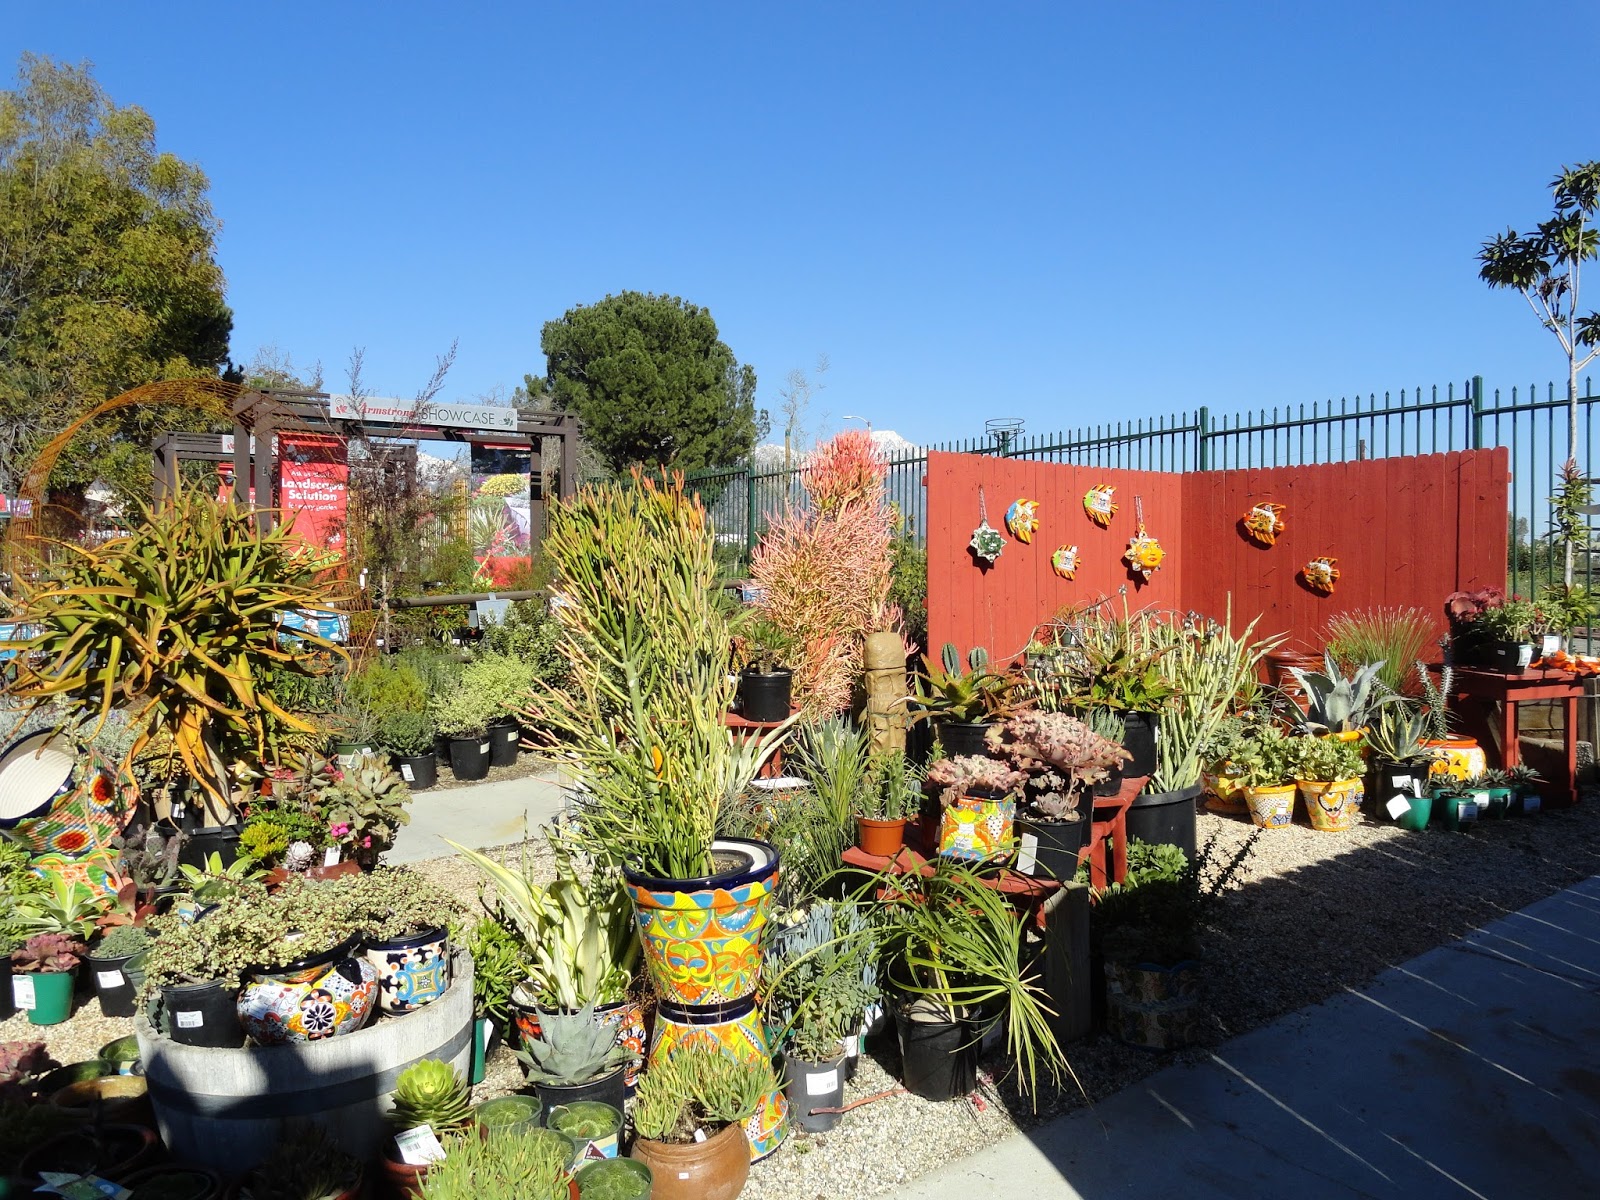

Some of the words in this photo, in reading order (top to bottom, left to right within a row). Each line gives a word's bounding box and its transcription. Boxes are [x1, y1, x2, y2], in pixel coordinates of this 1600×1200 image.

[358, 402, 417, 419] Armstrong
[421, 407, 495, 425] SHOWCASE
[281, 477, 345, 492] Landscape
[288, 489, 337, 501] Solution
